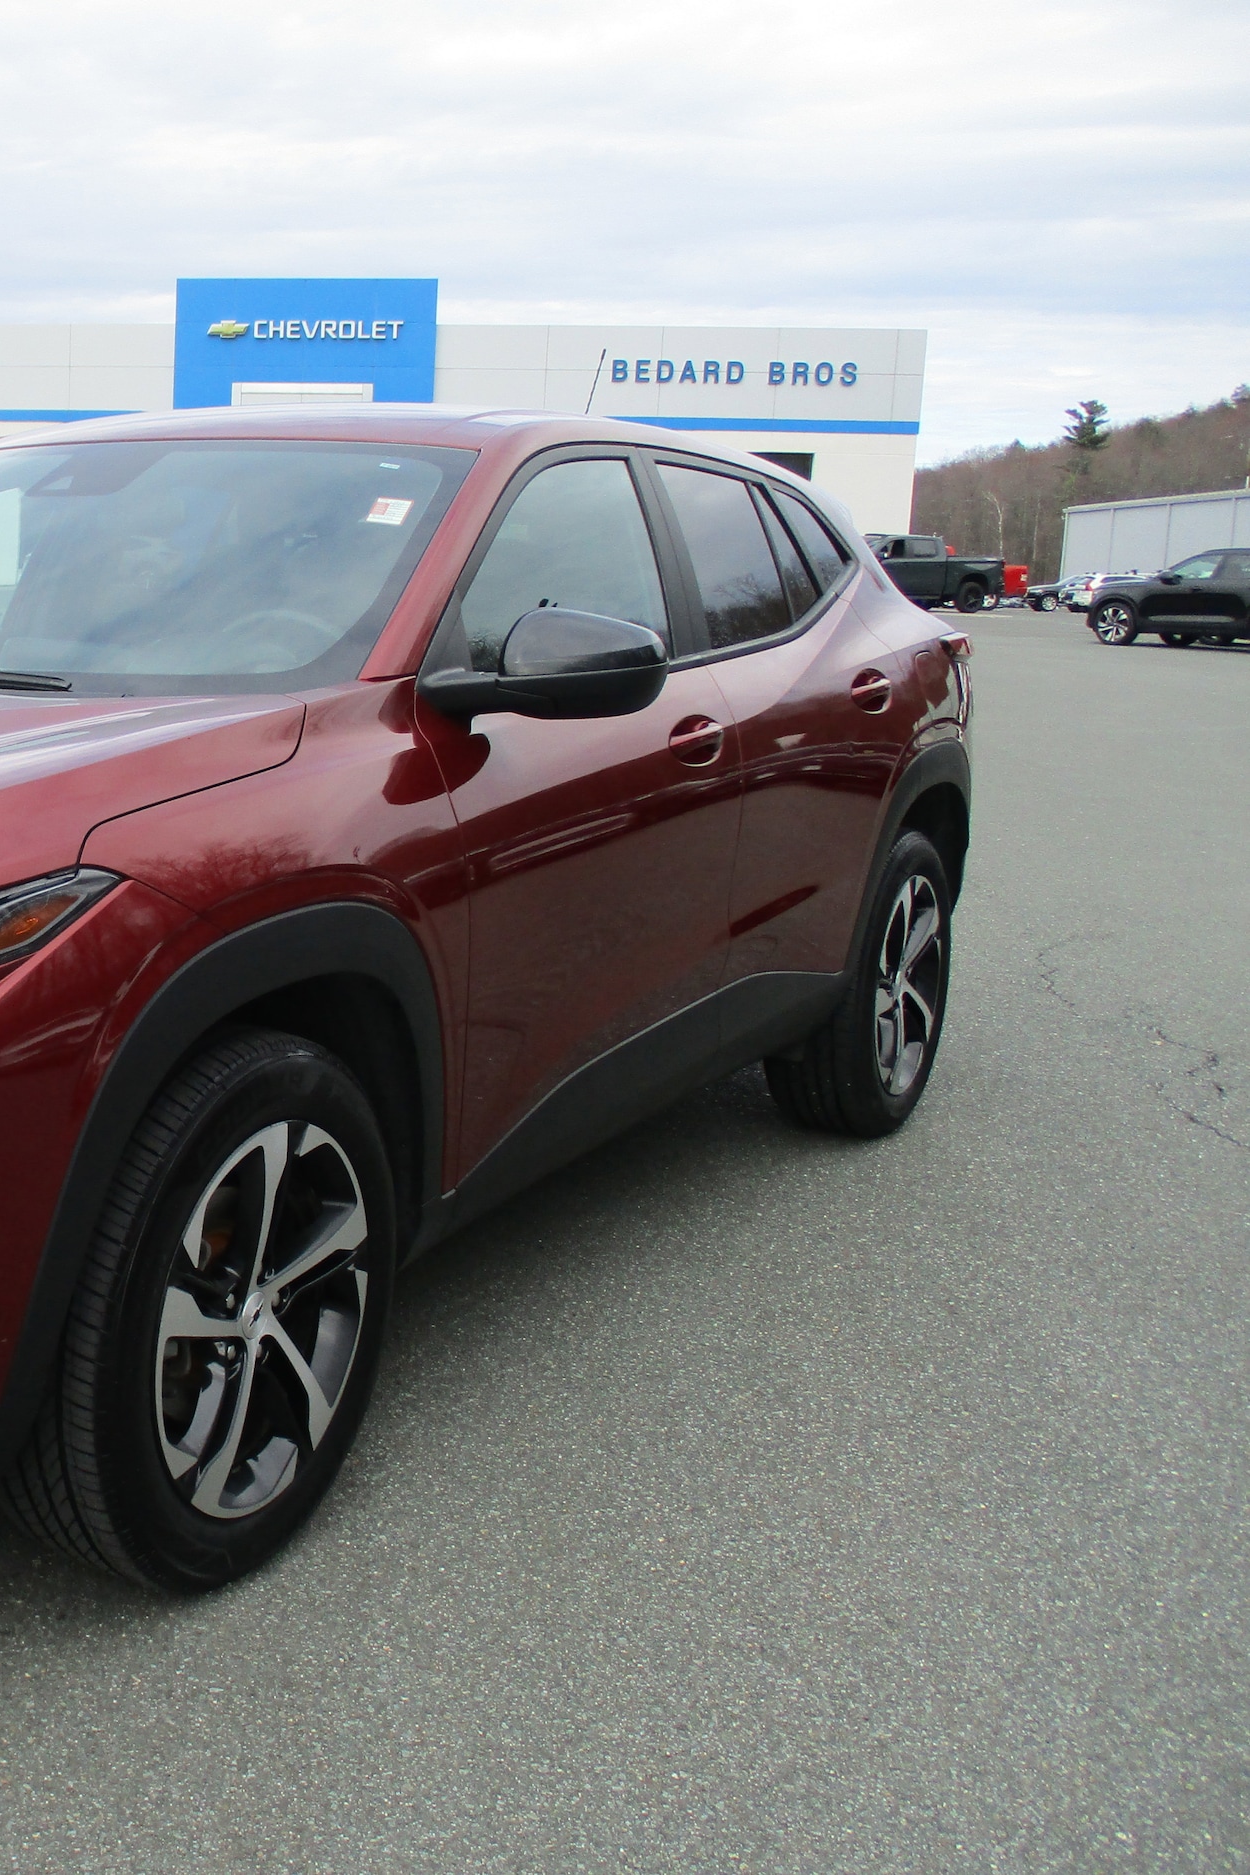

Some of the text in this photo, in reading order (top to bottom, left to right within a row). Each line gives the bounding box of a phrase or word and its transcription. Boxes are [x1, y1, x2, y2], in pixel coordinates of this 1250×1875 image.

[253, 320, 404, 340] CHEVROLET
[611, 359, 858, 386] BEDARD BROS
